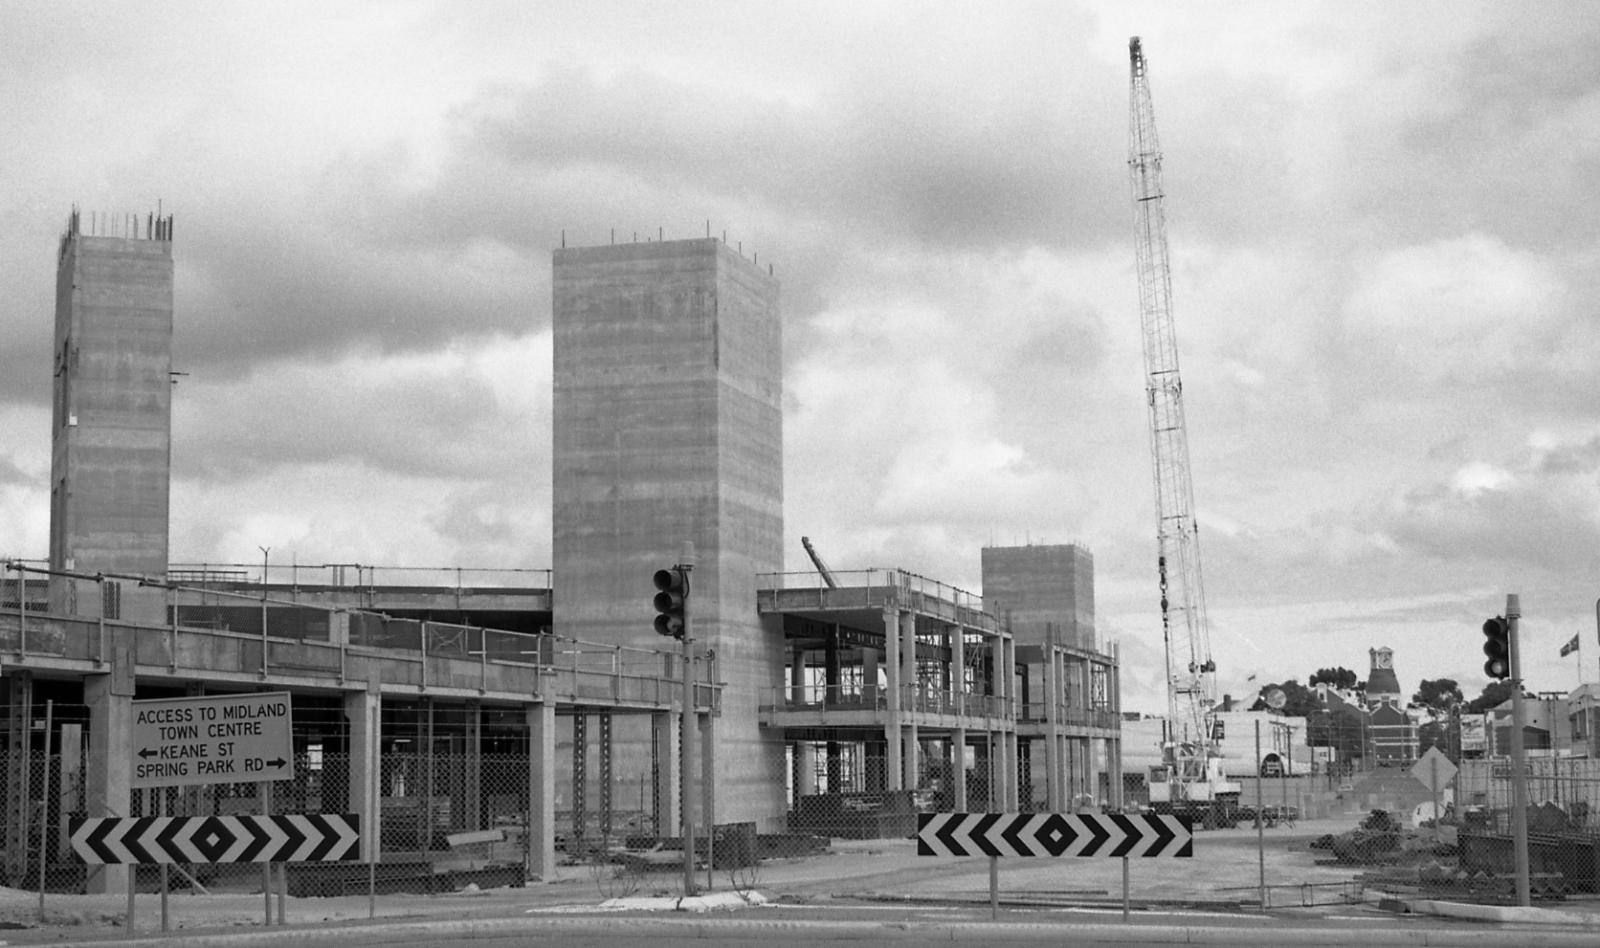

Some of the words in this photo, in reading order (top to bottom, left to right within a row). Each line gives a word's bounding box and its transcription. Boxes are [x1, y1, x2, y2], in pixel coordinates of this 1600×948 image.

[137, 708, 193, 724] ACCESS
[199, 707, 216, 720] TO
[223, 703, 286, 719] MIDLAND
[159, 725, 198, 740] TOWN
[208, 722, 262, 737] CENTRE
[160, 744, 208, 759] KEANE
[218, 743, 235, 756] ST
[137, 762, 188, 778] SPRING
[197, 760, 235, 774] PARK
[245, 758, 263, 771] RD
